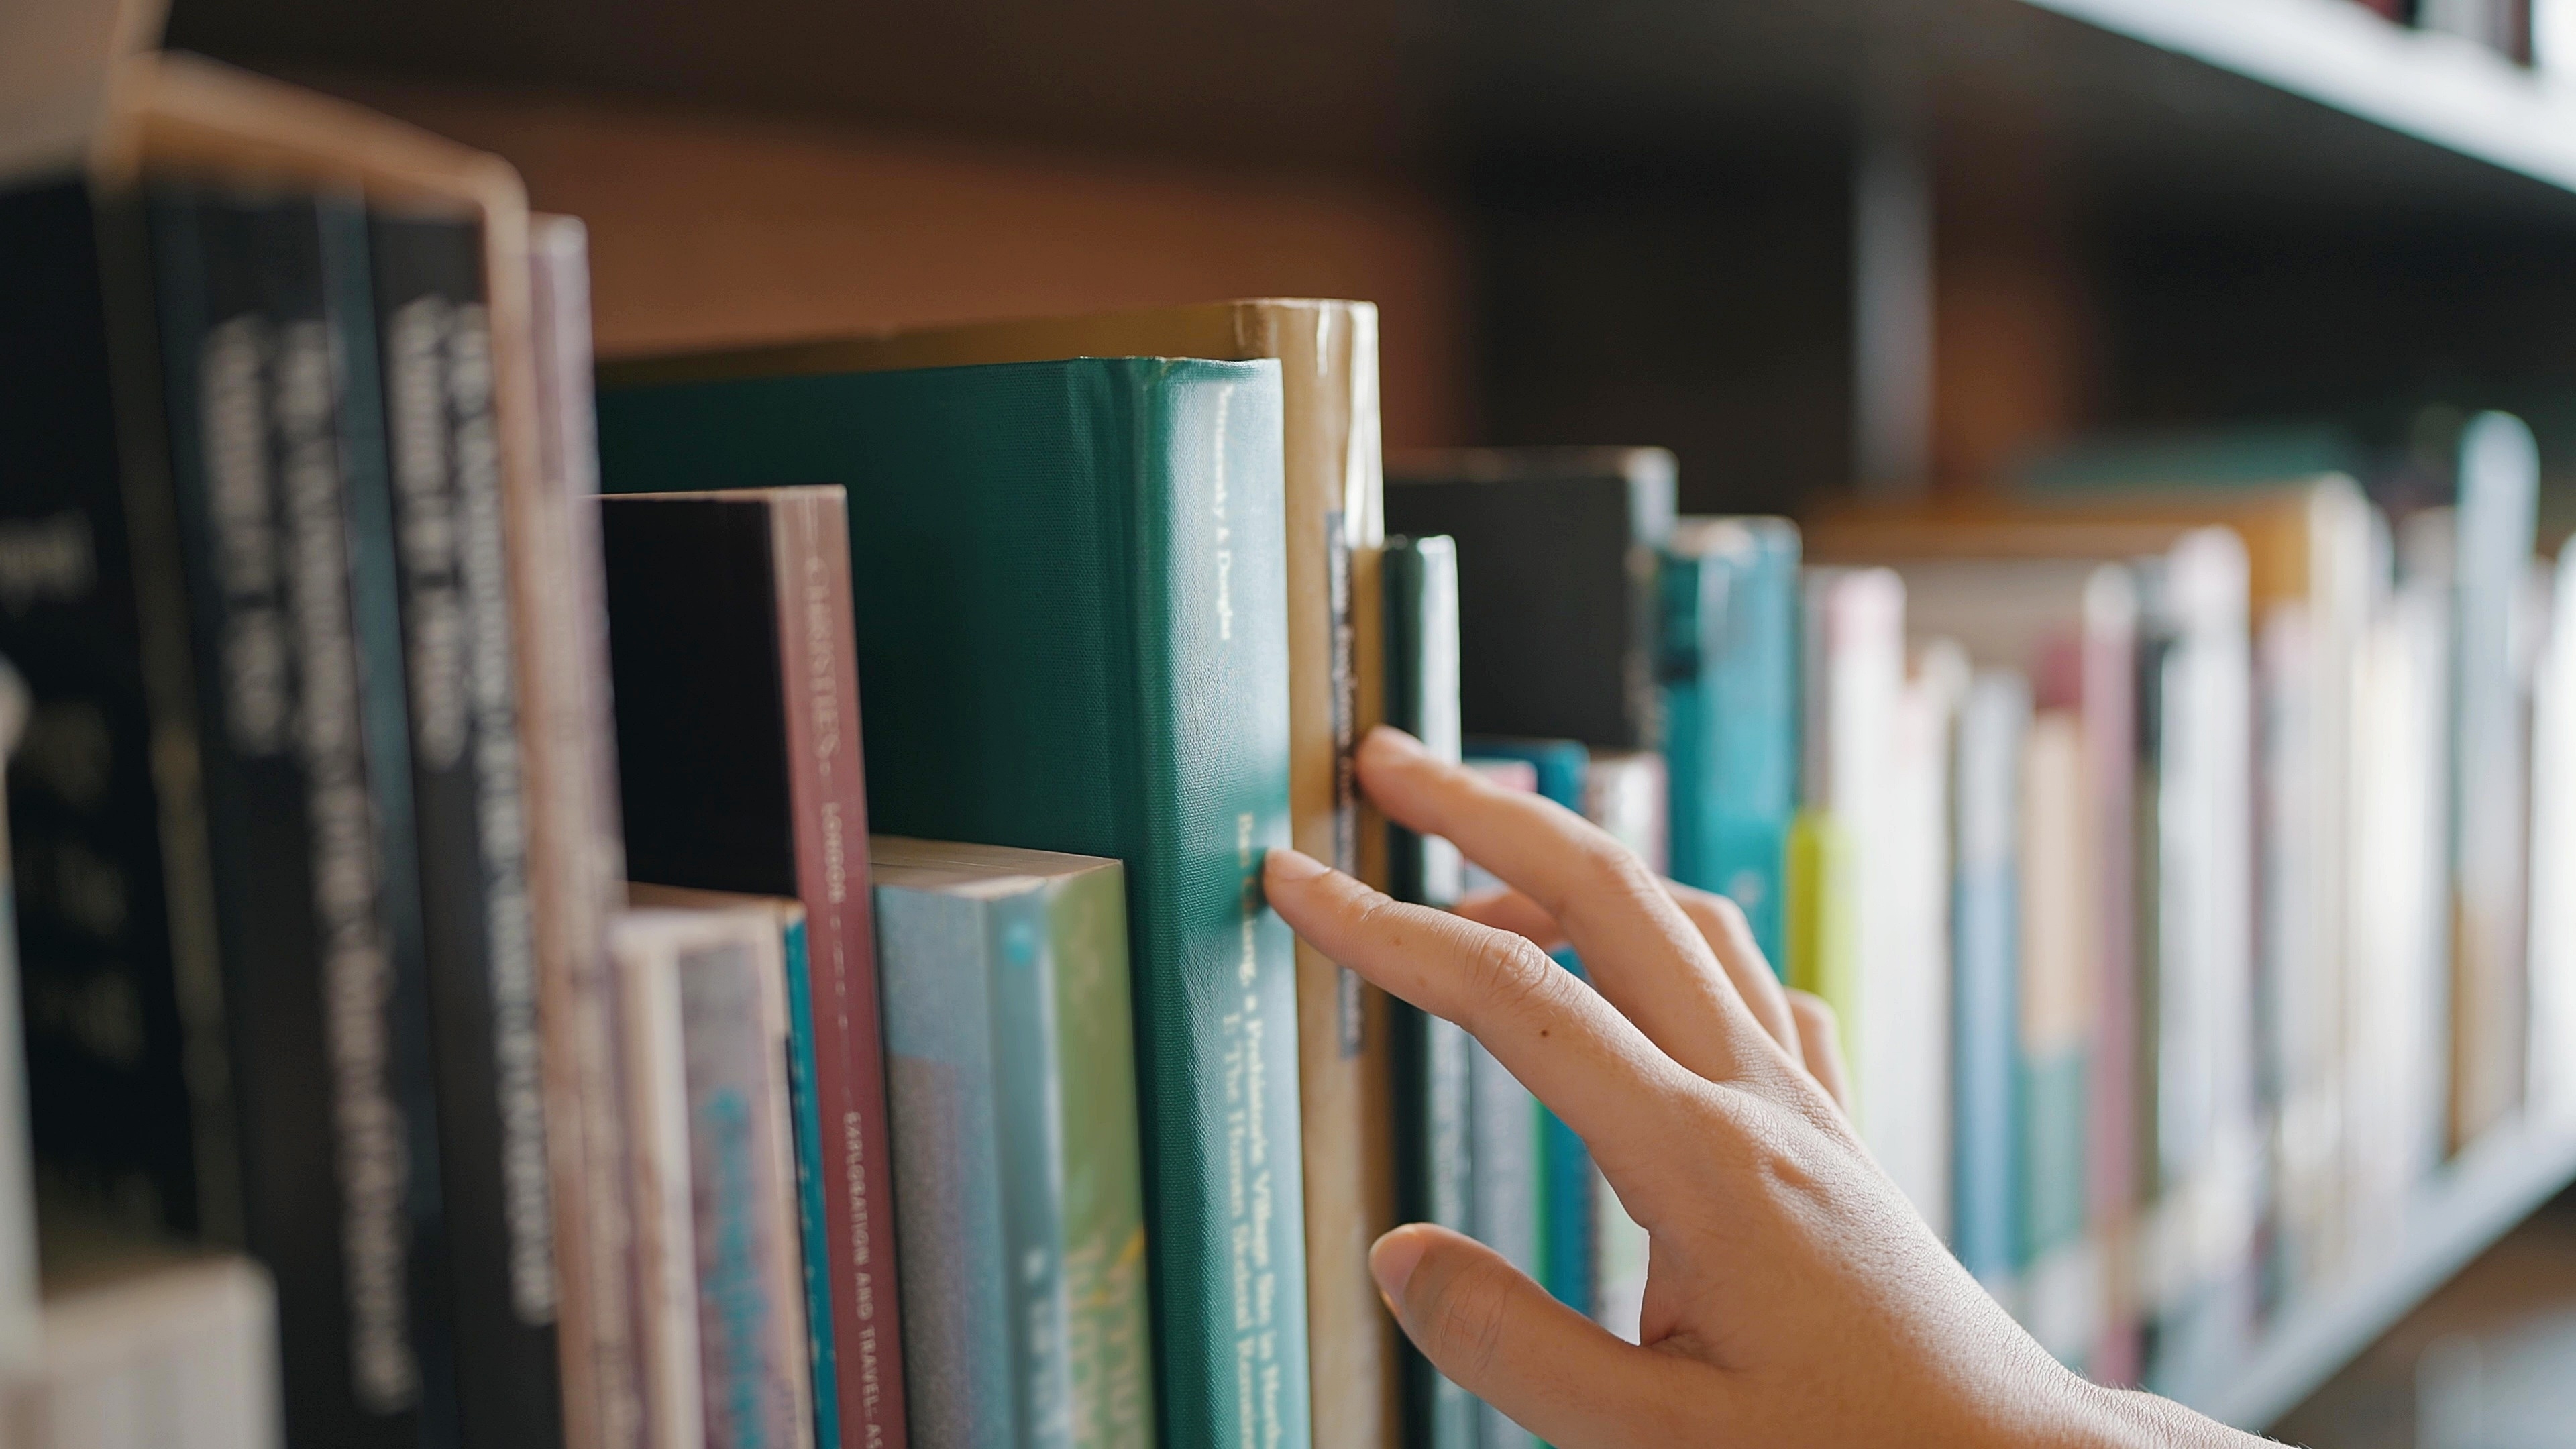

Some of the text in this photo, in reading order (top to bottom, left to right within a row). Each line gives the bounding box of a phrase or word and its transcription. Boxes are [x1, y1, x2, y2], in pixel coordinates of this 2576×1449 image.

[1215, 526, 1232, 545] &
[1215, 550, 1233, 641] Douglas
[821, 802, 845, 904] LONDON
[1238, 813, 1254, 867] Ban
[1244, 994, 1258, 1011] a
[1224, 1042, 1243, 1103] The
[1245, 1018, 1267, 1166] Prehistoric
[843, 1112, 870, 1266] EXPLORATION
[1228, 1110, 1247, 1218] Human
[1252, 1170, 1273, 1267] Village
[854, 1271, 874, 1320] AND
[1232, 1224, 1254, 1329] Skeletal
[1256, 1274, 1277, 1326] Site
[1258, 1329, 1278, 1360] in
